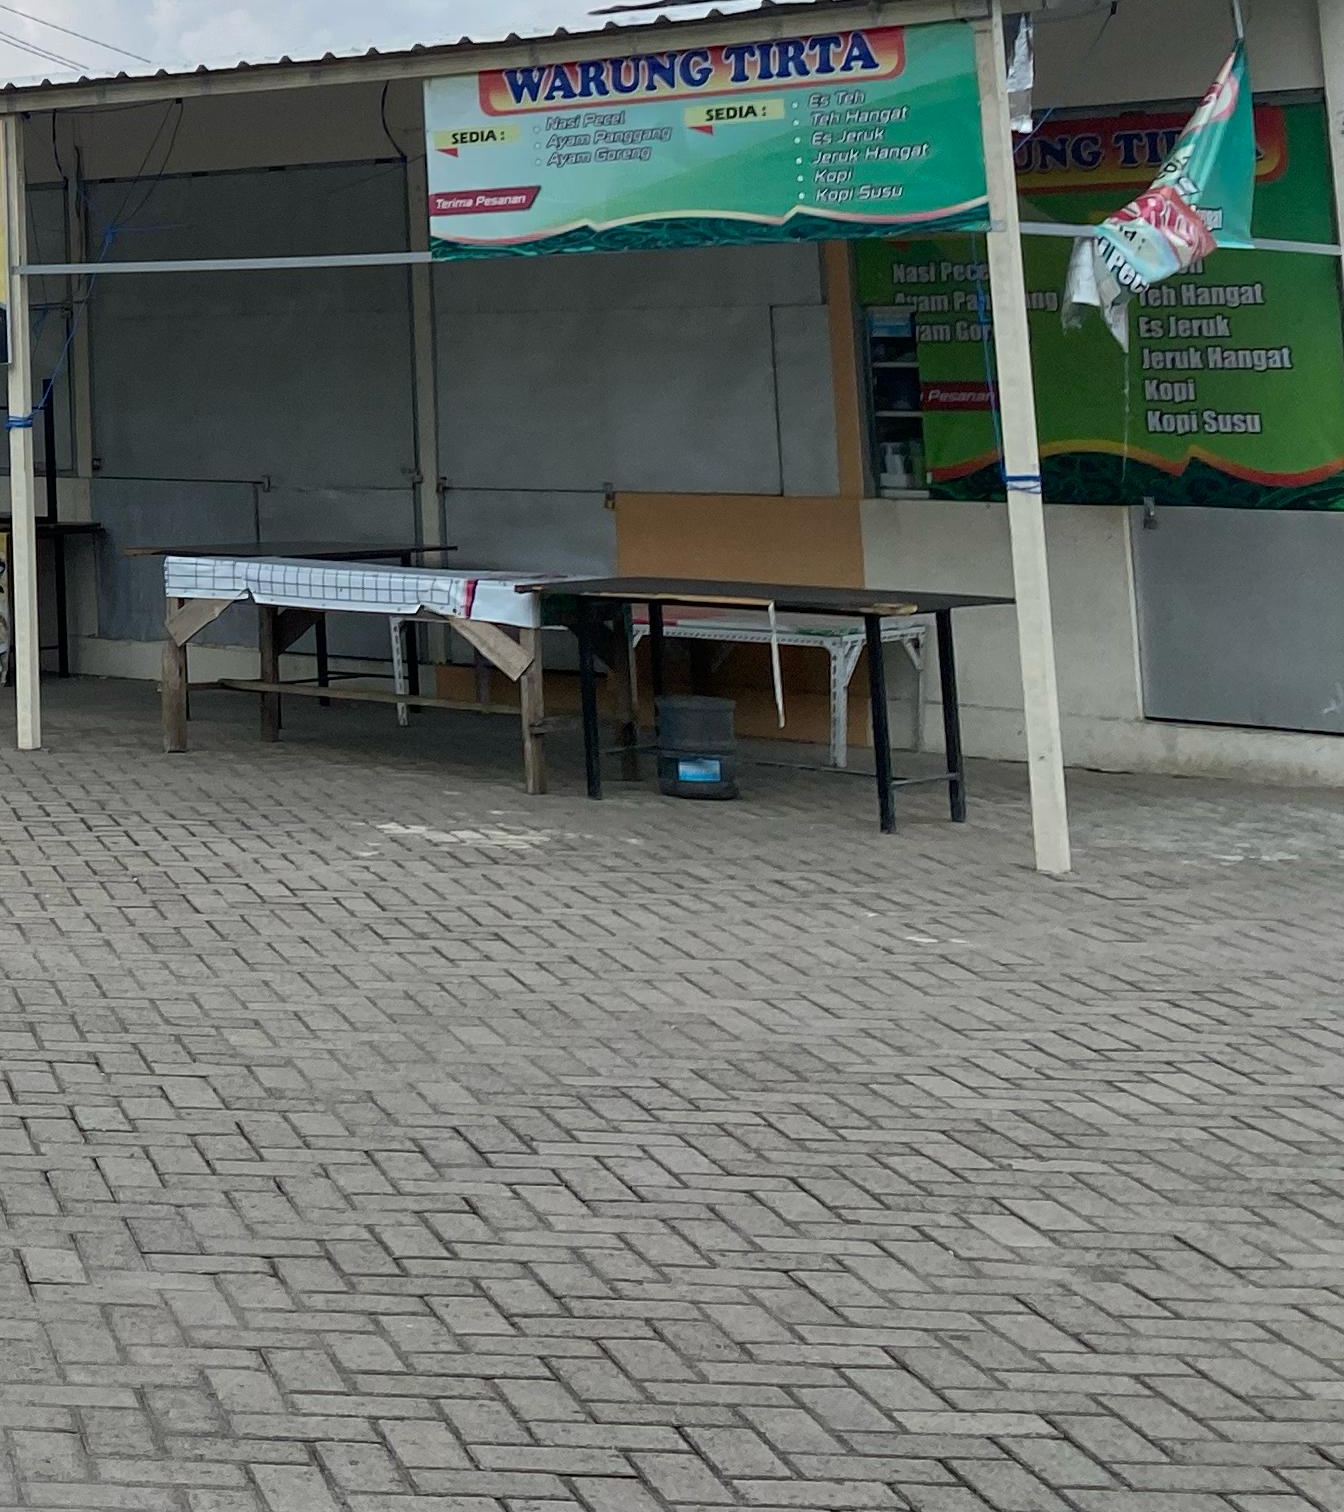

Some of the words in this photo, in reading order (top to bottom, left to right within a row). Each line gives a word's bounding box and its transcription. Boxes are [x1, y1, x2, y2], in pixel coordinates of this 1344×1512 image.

[502, 47, 713, 104] WARUNG
[723, 31, 880, 83] TIRTA
[809, 94, 831, 108] Es
[836, 90, 865, 105] Teh
[545, 116, 581, 131] Nasi
[583, 110, 626, 128] Pecel
[705, 105, 758, 121] SEDIA
[812, 112, 840, 127] Teh
[844, 104, 910, 125] Hangat
[451, 129, 497, 145] SEDIA
[546, 133, 591, 150] Ayam
[593, 126, 672, 146] Panggang
[812, 131, 832, 146] Es
[837, 126, 885, 143] Jeruk
[546, 150, 591, 168] Ayam
[594, 146, 652, 162] Goreng
[812, 149, 859, 166] Jeruk
[864, 142, 929, 163] Hangat
[814, 169, 853, 185] Kopi
[435, 196, 473, 209] Terima
[475, 193, 526, 208] Pesanan
[816, 186, 854, 204] Kopi
[858, 183, 904, 200] Susu
[892, 262, 936, 284] Nasi
[940, 261, 990, 283] Pece
[1139, 285, 1176, 307] Teh
[1180, 283, 1265, 307] Hangat
[1138, 316, 1164, 338] Es
[1169, 314, 1231, 338] Jeruk
[1142, 347, 1204, 370] Jeruk
[1207, 346, 1293, 371] Hangat
[928, 389, 996, 403] Pesanan
[1144, 379, 1196, 403] Kopi
[1147, 410, 1199, 434] Kopi
[1202, 410, 1262, 434] Susu
